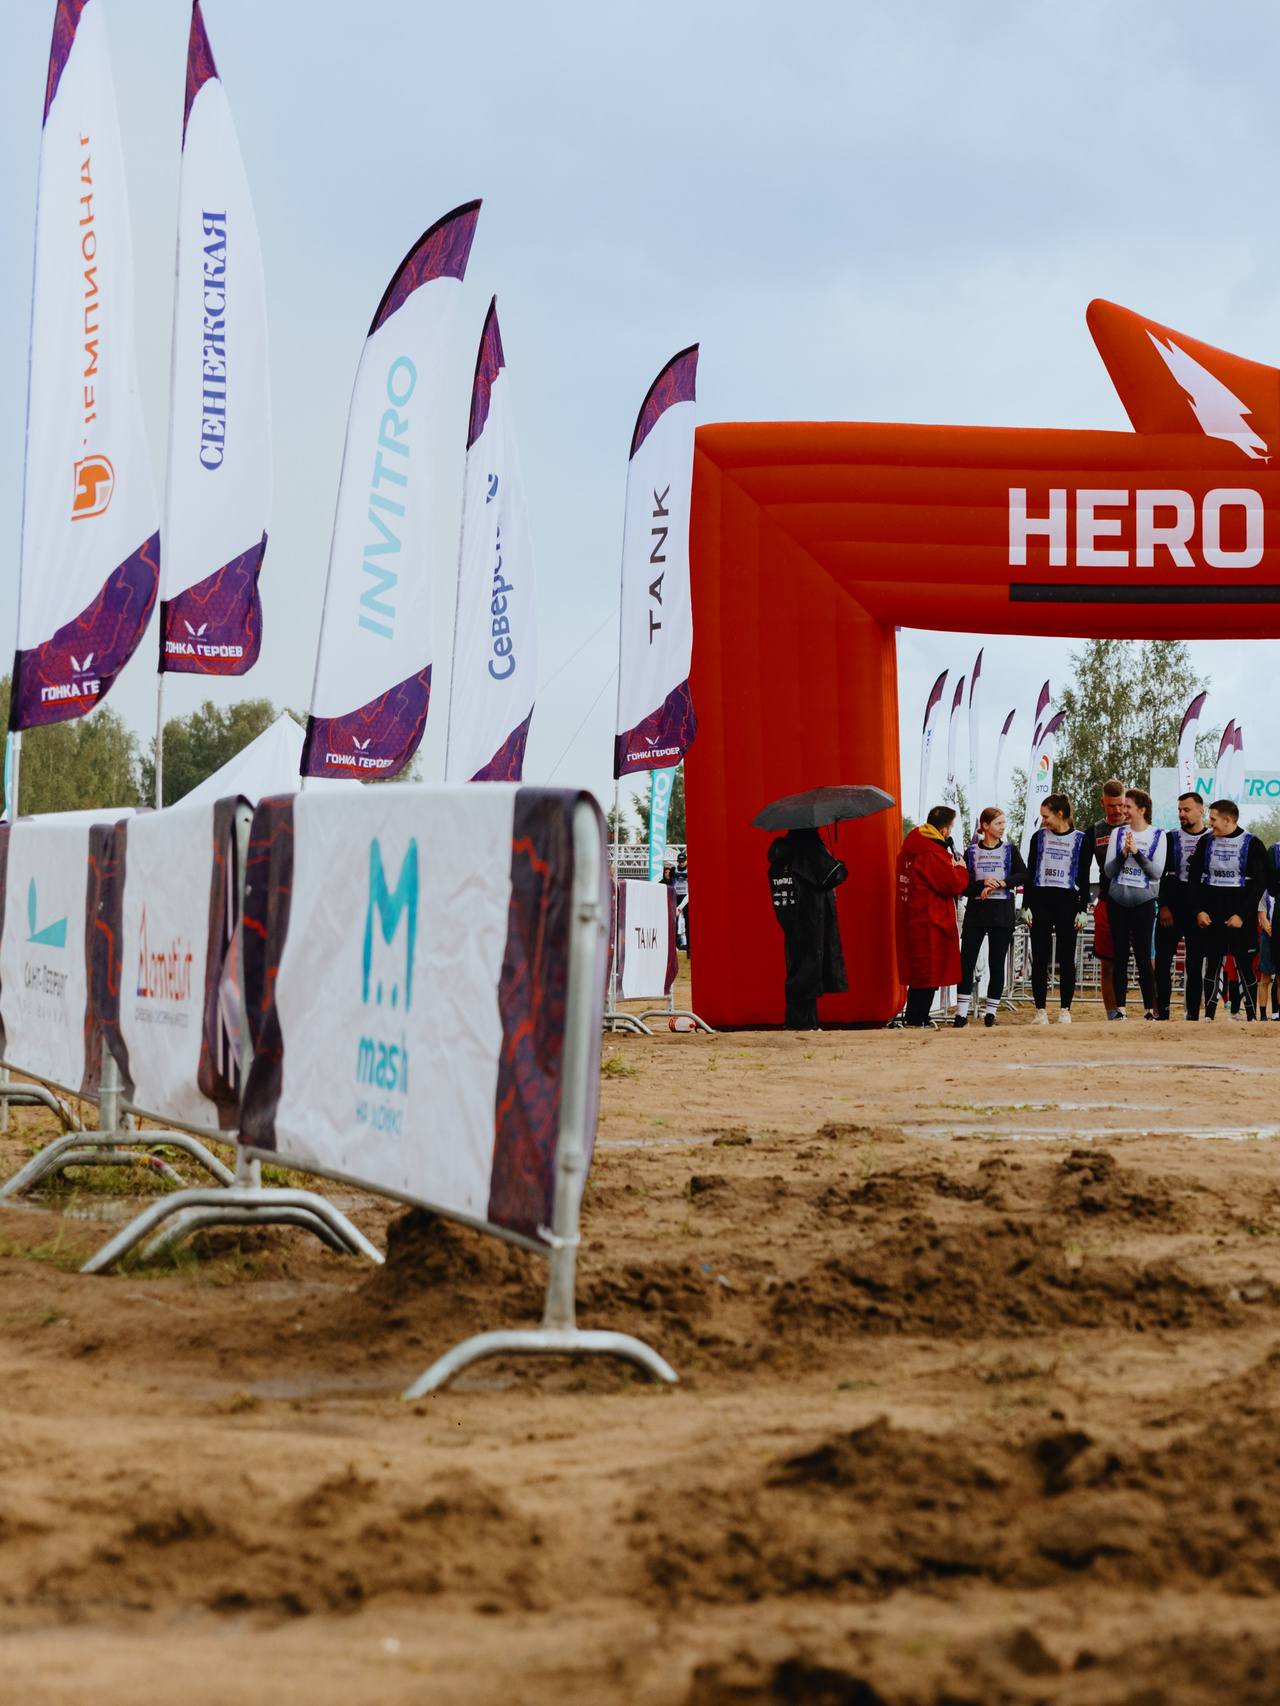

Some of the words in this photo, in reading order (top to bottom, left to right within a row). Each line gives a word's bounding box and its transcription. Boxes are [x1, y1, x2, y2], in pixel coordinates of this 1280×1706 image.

[199, 209, 227, 470] СЕНЕЖСКАЯ
[358, 355, 417, 640] INVITRO
[1008, 487, 1264, 569] HERO
[649, 484, 671, 645] TANK
[197, 644, 243, 657] ГЕРОЕВ
[41, 681, 81, 701] ГОНКА
[326, 753, 356, 766] ГОНКА
[626, 751, 651, 761] ГОНКА
[649, 772, 670, 882] NVITRO
[1045, 868, 1065, 878] 08510
[1214, 870, 1235, 878] 08503
[635, 927, 658, 949] TANK
